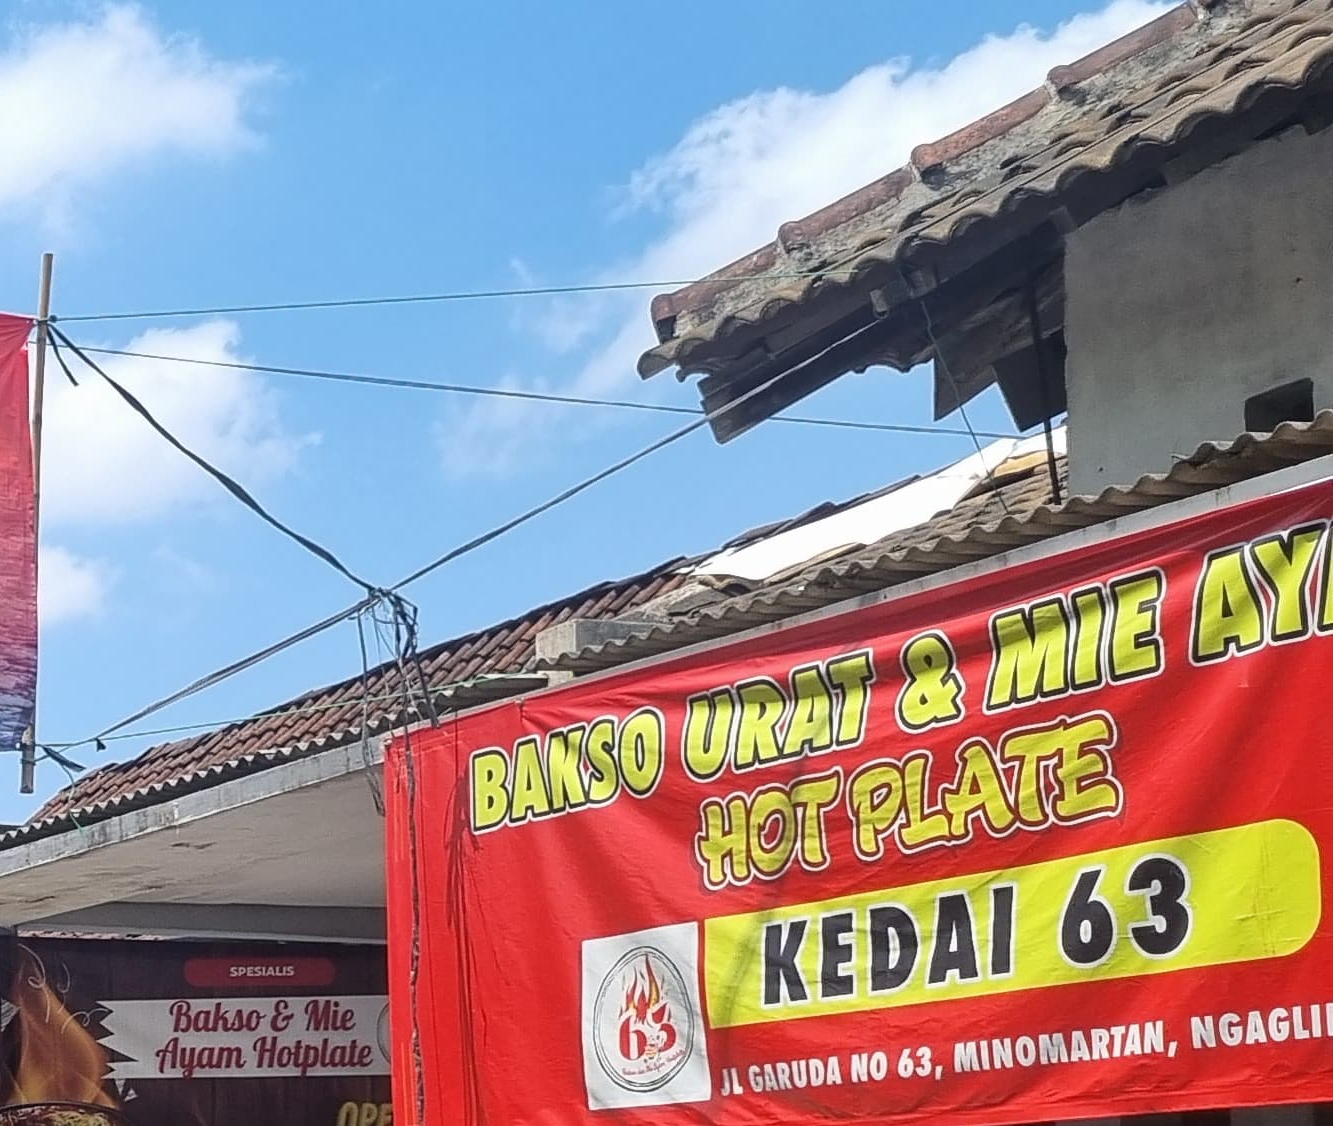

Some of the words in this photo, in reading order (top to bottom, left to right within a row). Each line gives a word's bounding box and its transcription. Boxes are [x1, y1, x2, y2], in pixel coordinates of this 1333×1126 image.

[469, 705, 666, 835] BAKSO
[682, 648, 875, 783] URAT
[897, 630, 964, 735] &
[985, 566, 1167, 715] MIE
[1188, 516, 1333, 667] AY
[695, 766, 843, 891] HOT
[848, 711, 1125, 863] PLATE
[761, 881, 1017, 1008] KEDAI
[1057, 854, 1194, 969] 63
[229, 966, 294, 977] SPESIALIS
[169, 1000, 266, 1033] Bakso
[270, 1000, 294, 1032] &
[304, 1000, 357, 1032] Mie
[155, 1037, 247, 1079] Ayam
[253, 1036, 374, 1077] Hotplate
[721, 1067, 744, 1096] JL
[749, 1056, 842, 1093] GARUDA
[850, 1051, 888, 1083] NO
[897, 1046, 943, 1080] 63,
[953, 1020, 1178, 1073] MINOMARTAN,
